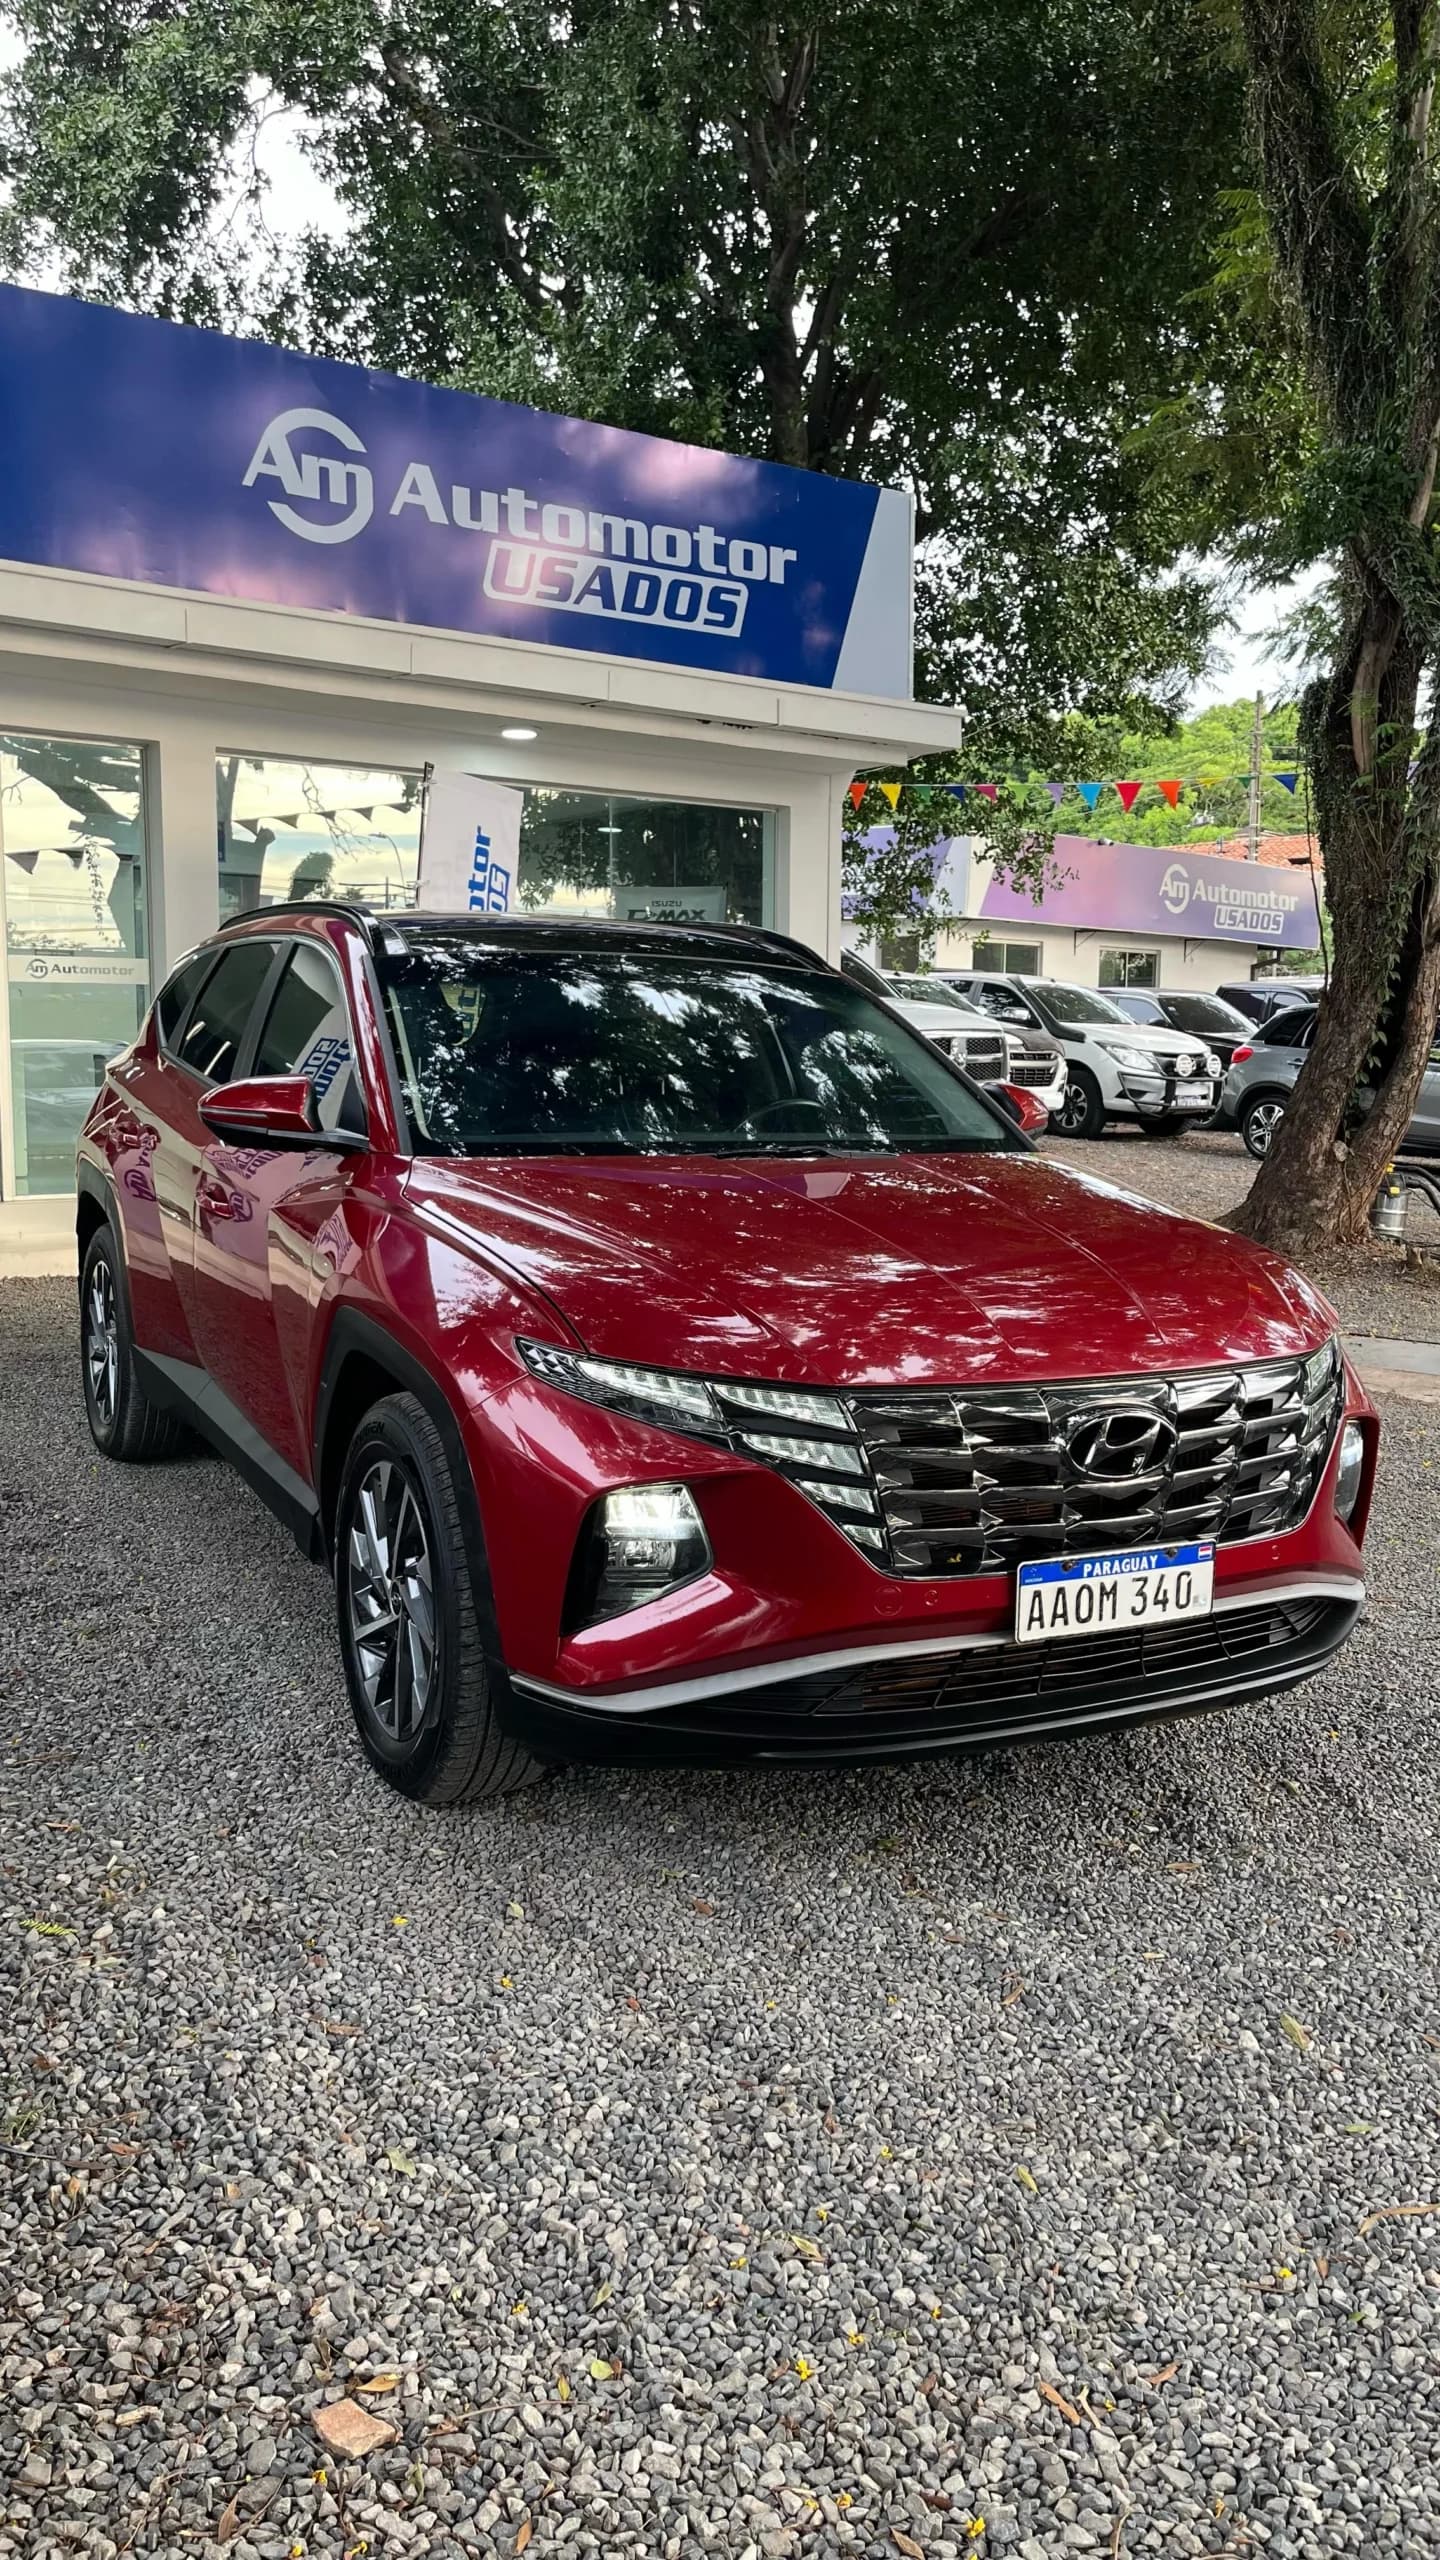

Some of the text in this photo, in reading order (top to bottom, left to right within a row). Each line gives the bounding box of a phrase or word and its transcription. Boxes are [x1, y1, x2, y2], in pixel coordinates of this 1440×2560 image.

[389, 463, 797, 584] Automotor
[490, 547, 741, 628] USADOS
[1192, 879, 1299, 911] Automotor
[1216, 908, 1282, 932] USADOS
[51, 964, 134, 975] Automotor
[1083, 1555, 1158, 1577] PARAGUAY
[1027, 1571, 1192, 1631] AAOM 340
